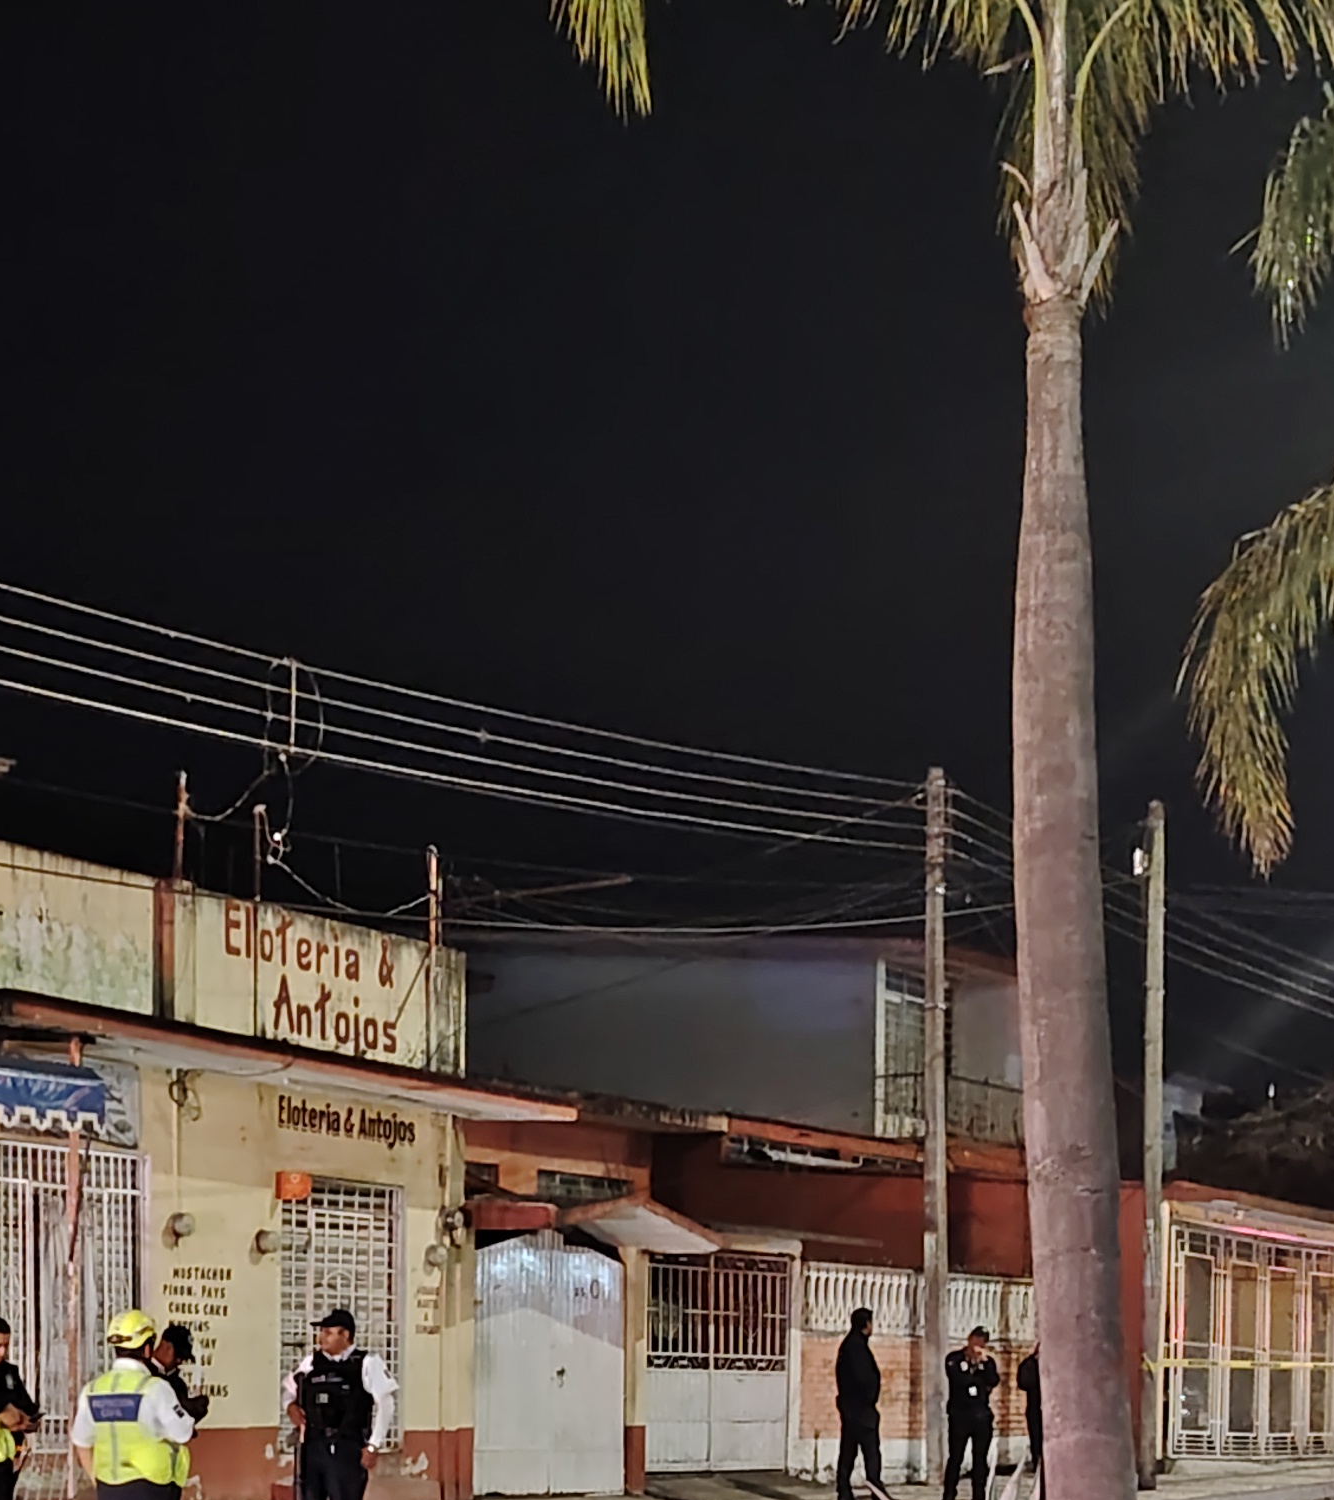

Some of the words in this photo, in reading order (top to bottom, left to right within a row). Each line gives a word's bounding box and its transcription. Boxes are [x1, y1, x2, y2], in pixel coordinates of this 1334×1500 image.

[378, 935, 394, 988] &
[273, 973, 397, 1055] Antojos
[278, 1094, 341, 1135] Eloteria
[343, 1106, 355, 1135] &
[358, 1107, 416, 1149] Antojos
[201, 1285, 226, 1299] PAYS
